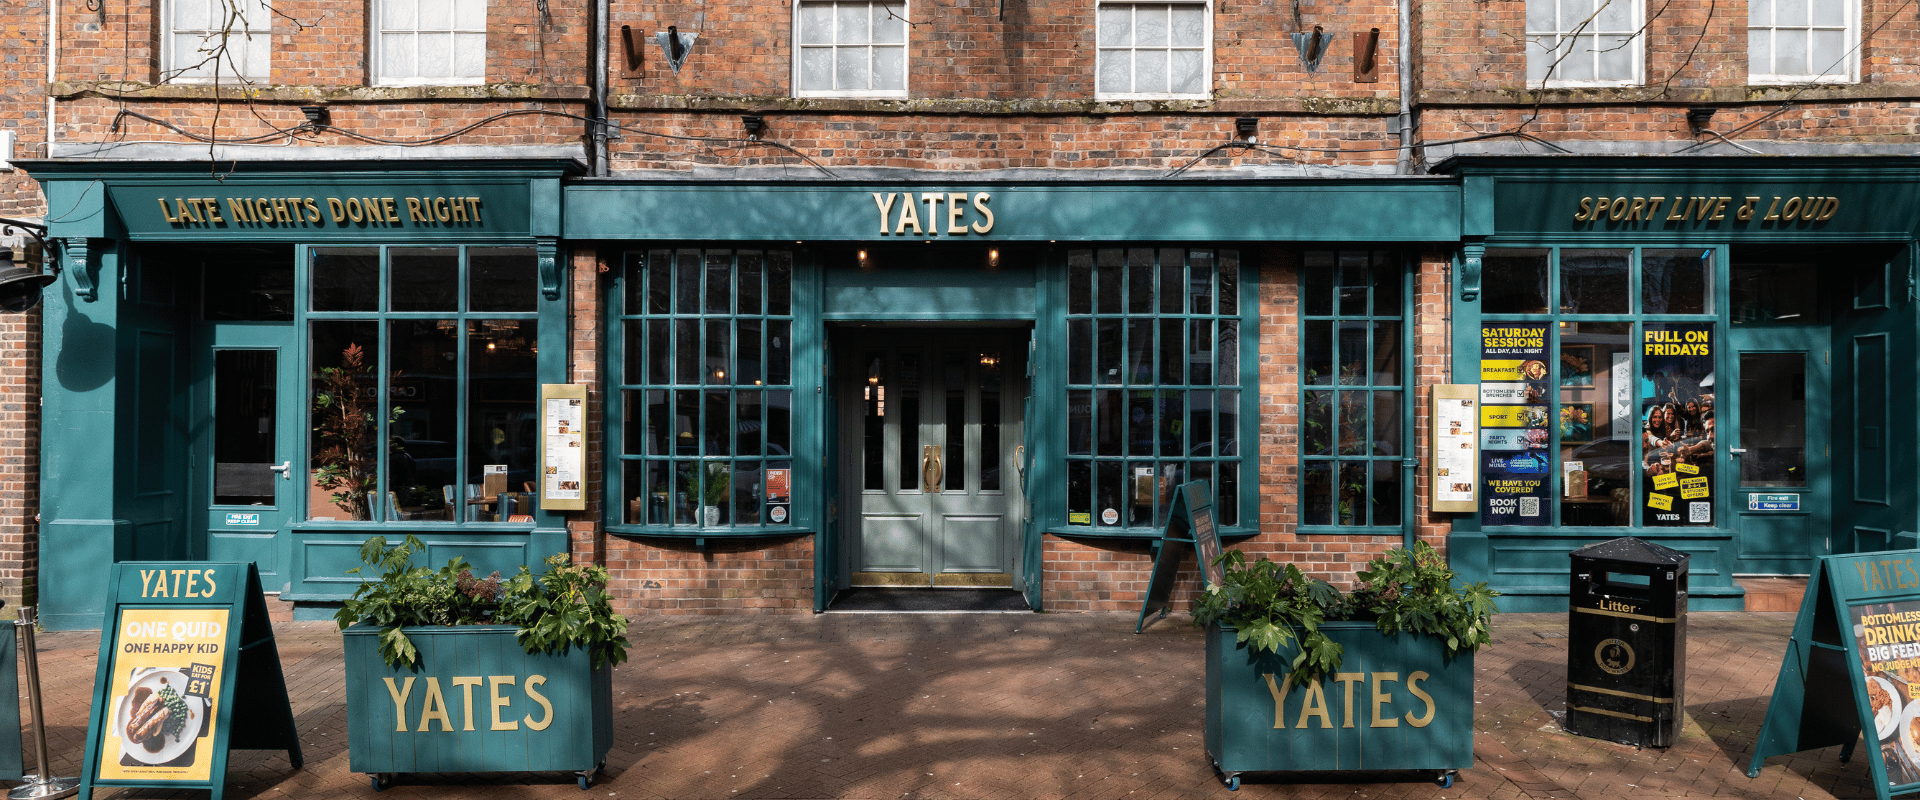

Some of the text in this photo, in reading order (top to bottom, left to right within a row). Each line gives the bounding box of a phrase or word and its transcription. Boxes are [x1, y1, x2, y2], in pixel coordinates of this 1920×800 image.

[158, 197, 481, 222] LATE NIGHTS DONE RIGHT
[872, 192, 994, 235] YATES
[1575, 197, 1839, 221] SPORT LIVE & LOUD
[1482, 328, 1546, 337] SATURDAY
[1645, 331, 1708, 342] FULL ON
[1484, 338, 1543, 347] SESSIONS
[1645, 344, 1709, 355] FRIDAYS
[1854, 559, 1919, 591] YATES
[140, 569, 216, 598] YATES
[1600, 600, 1636, 613] Litter
[1861, 610, 1920, 626] BOTTOMLESS
[126, 621, 221, 642] ONE QUID
[124, 643, 219, 654] ONE HAPPY KID
[1867, 646, 1890, 661] BIG
[192, 664, 213, 675] KIDS
[1871, 662, 1884, 672] NO
[382, 674, 553, 731] YATES
[1262, 670, 1435, 729] YATES
